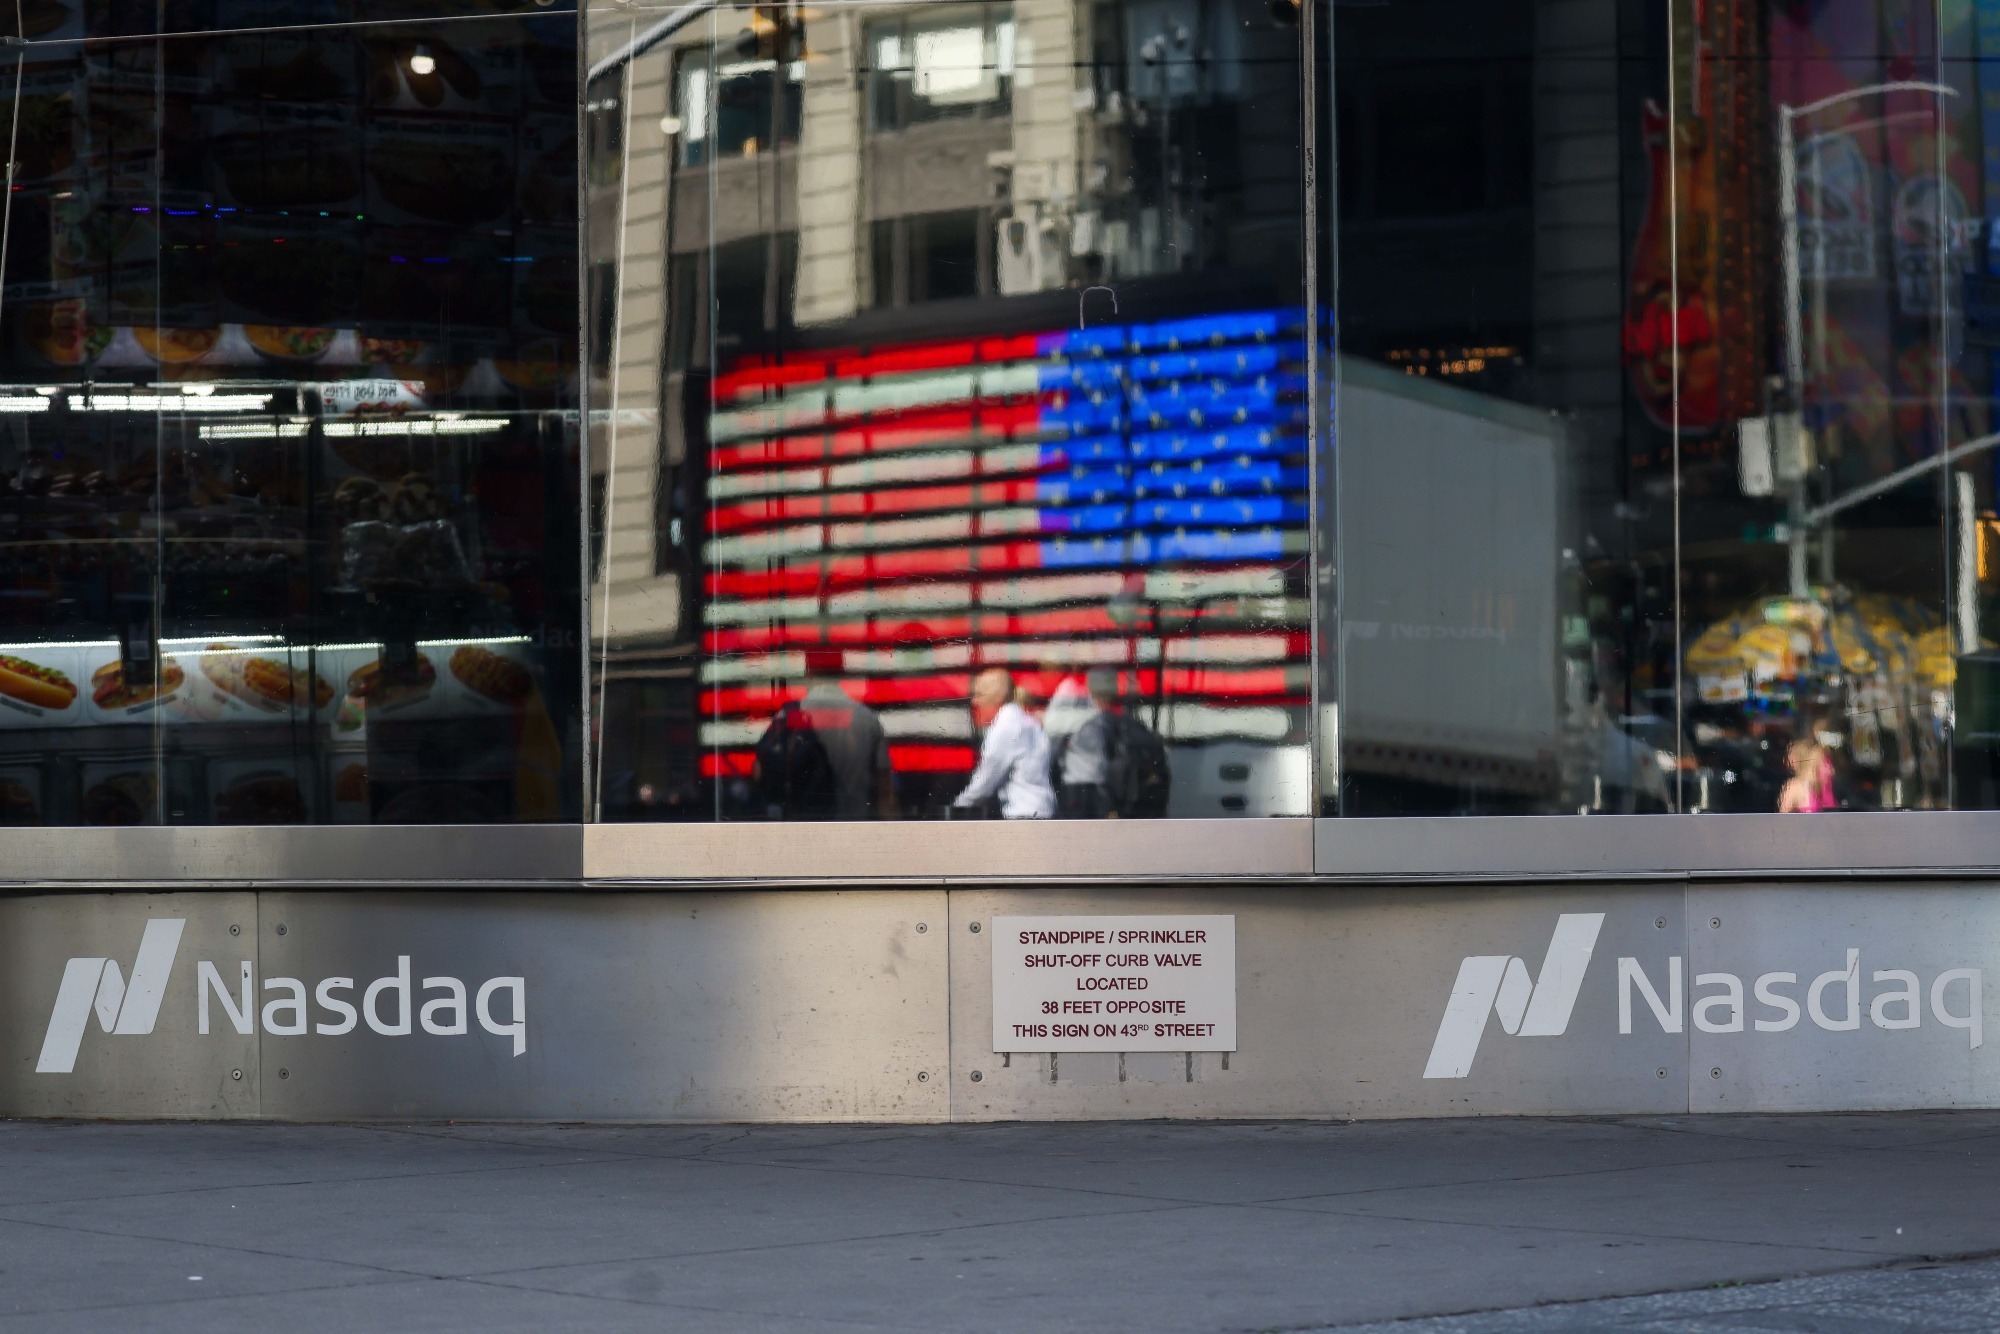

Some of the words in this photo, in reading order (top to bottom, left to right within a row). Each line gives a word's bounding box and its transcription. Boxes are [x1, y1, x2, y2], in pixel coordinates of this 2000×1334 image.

[1019, 930, 1105, 944] STANDPIPE
[1108, 930, 1115, 944] /
[1117, 930, 1207, 944] SPRINKLER
[1024, 954, 1101, 968] SHUT-OFF
[1105, 953, 1149, 967] CURB
[1153, 953, 1202, 967] VALVE
[1076, 977, 1148, 991] LOCATED
[197, 955, 526, 1057] Nasdaq
[1617, 948, 1984, 1050] Nasdaq
[1041, 1000, 1059, 1014] 38
[1063, 1000, 1102, 1014] FEET
[1105, 1000, 1186, 1014] OPPOSITE
[1012, 1024, 1048, 1038] THIS
[1051, 1023, 1089, 1038] SIGN
[1093, 1023, 1116, 1038] ON
[1120, 1023, 1149, 1038] 43RD
[1154, 1023, 1216, 1037] STREET
